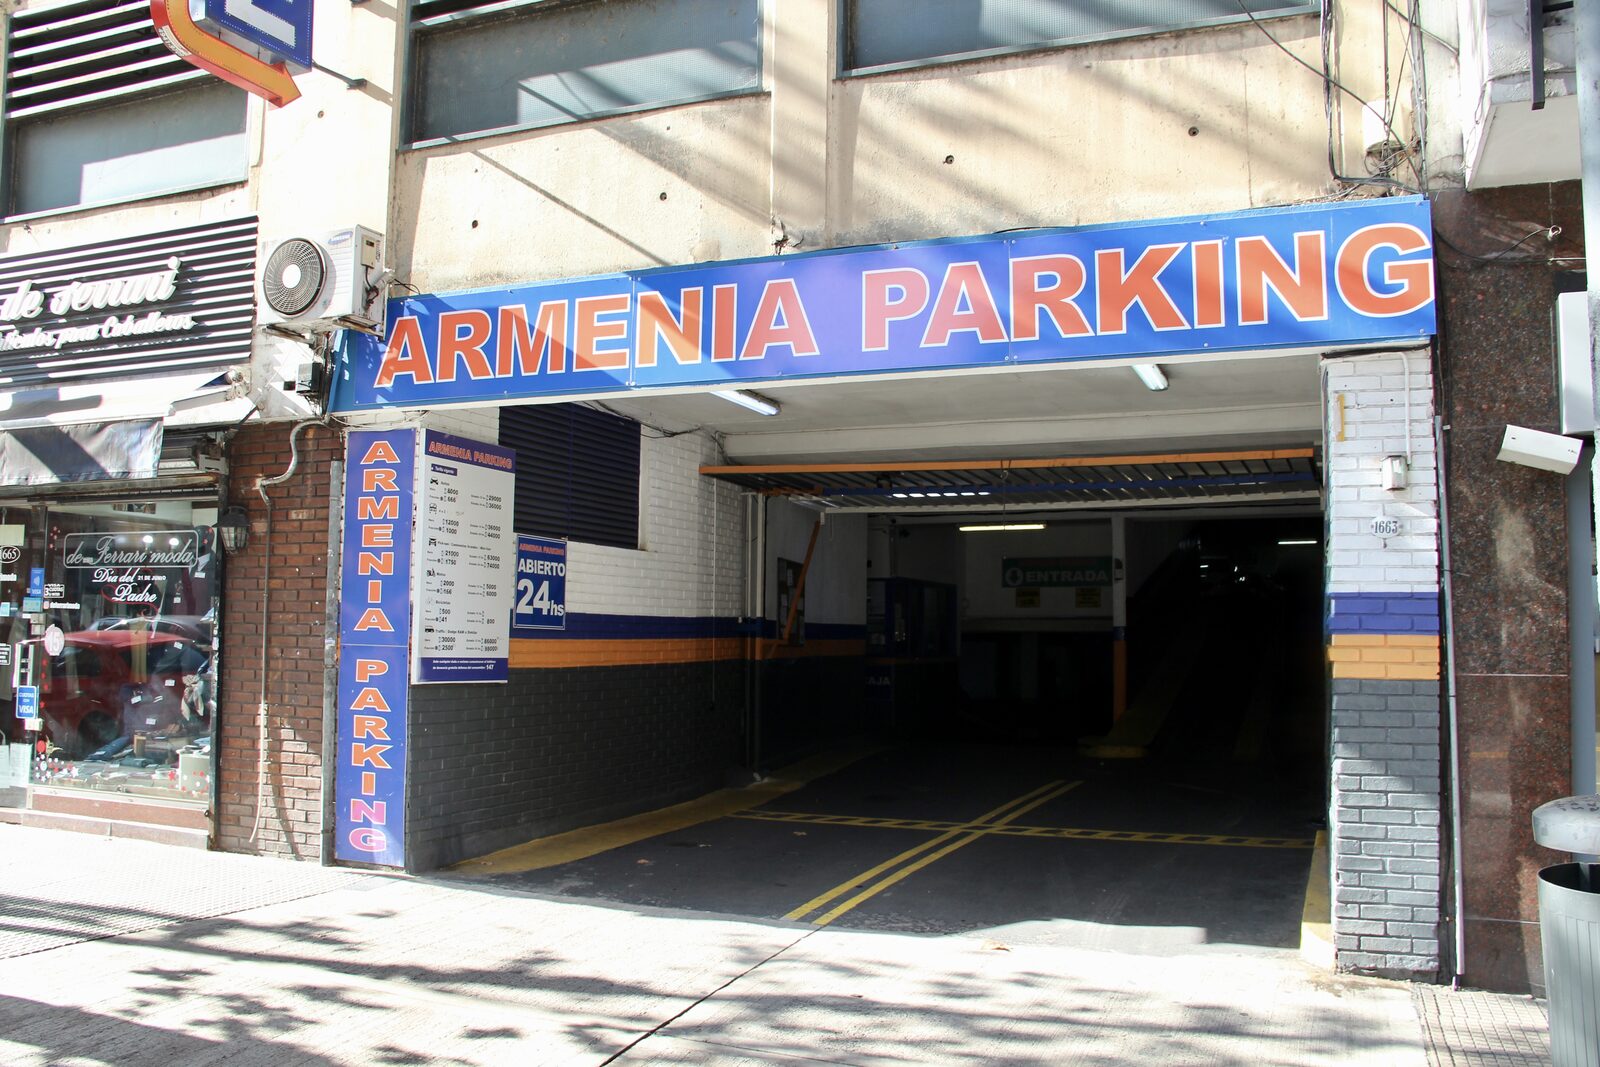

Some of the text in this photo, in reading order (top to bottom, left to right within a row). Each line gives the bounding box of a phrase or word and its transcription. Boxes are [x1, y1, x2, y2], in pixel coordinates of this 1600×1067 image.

[373, 222, 1435, 389] ARMENIA PARKING
[428, 441, 513, 469] ARMENIA PARKING
[353, 440, 401, 632] ARMENIA
[1374, 520, 1398, 534] 1663
[66, 536, 195, 564] de Ferrari moda
[118, 566, 140, 582] del
[518, 558, 566, 577] ABIERTO
[1024, 570, 1108, 582] ENTRADA
[112, 582, 158, 602] Padre
[18, 705, 34, 714] VISA
[348, 658, 394, 852] PARKING
